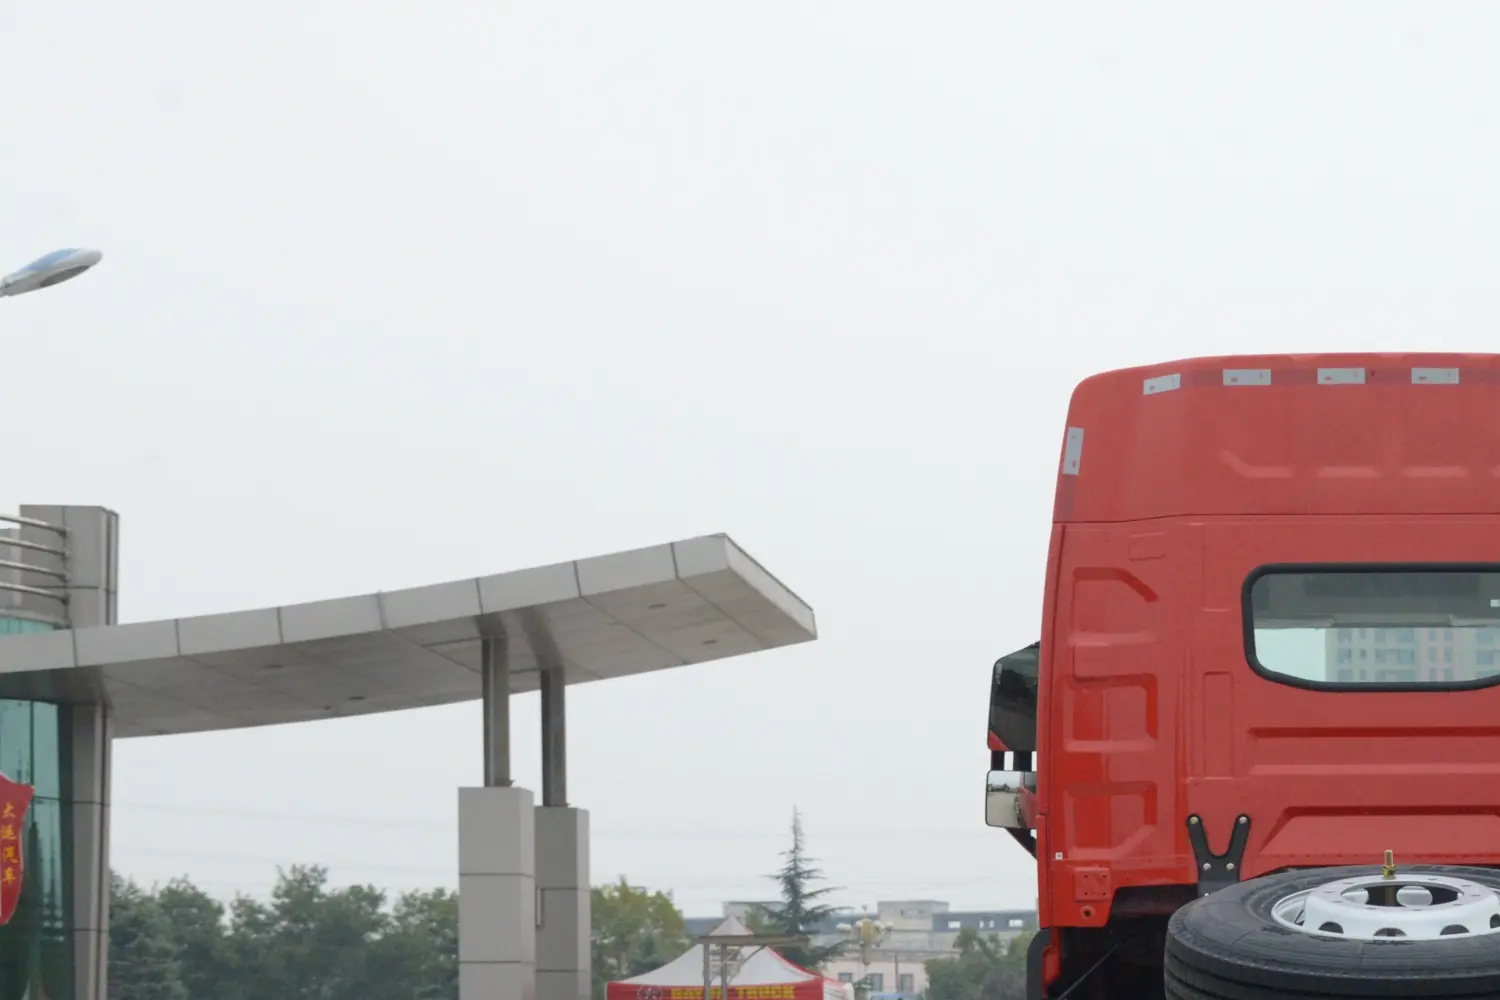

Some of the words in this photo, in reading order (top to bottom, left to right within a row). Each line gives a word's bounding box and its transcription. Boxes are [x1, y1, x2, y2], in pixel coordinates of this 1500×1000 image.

[1, 801, 19, 886] 大运汽车
[736, 985, 795, 999] TRUCK
